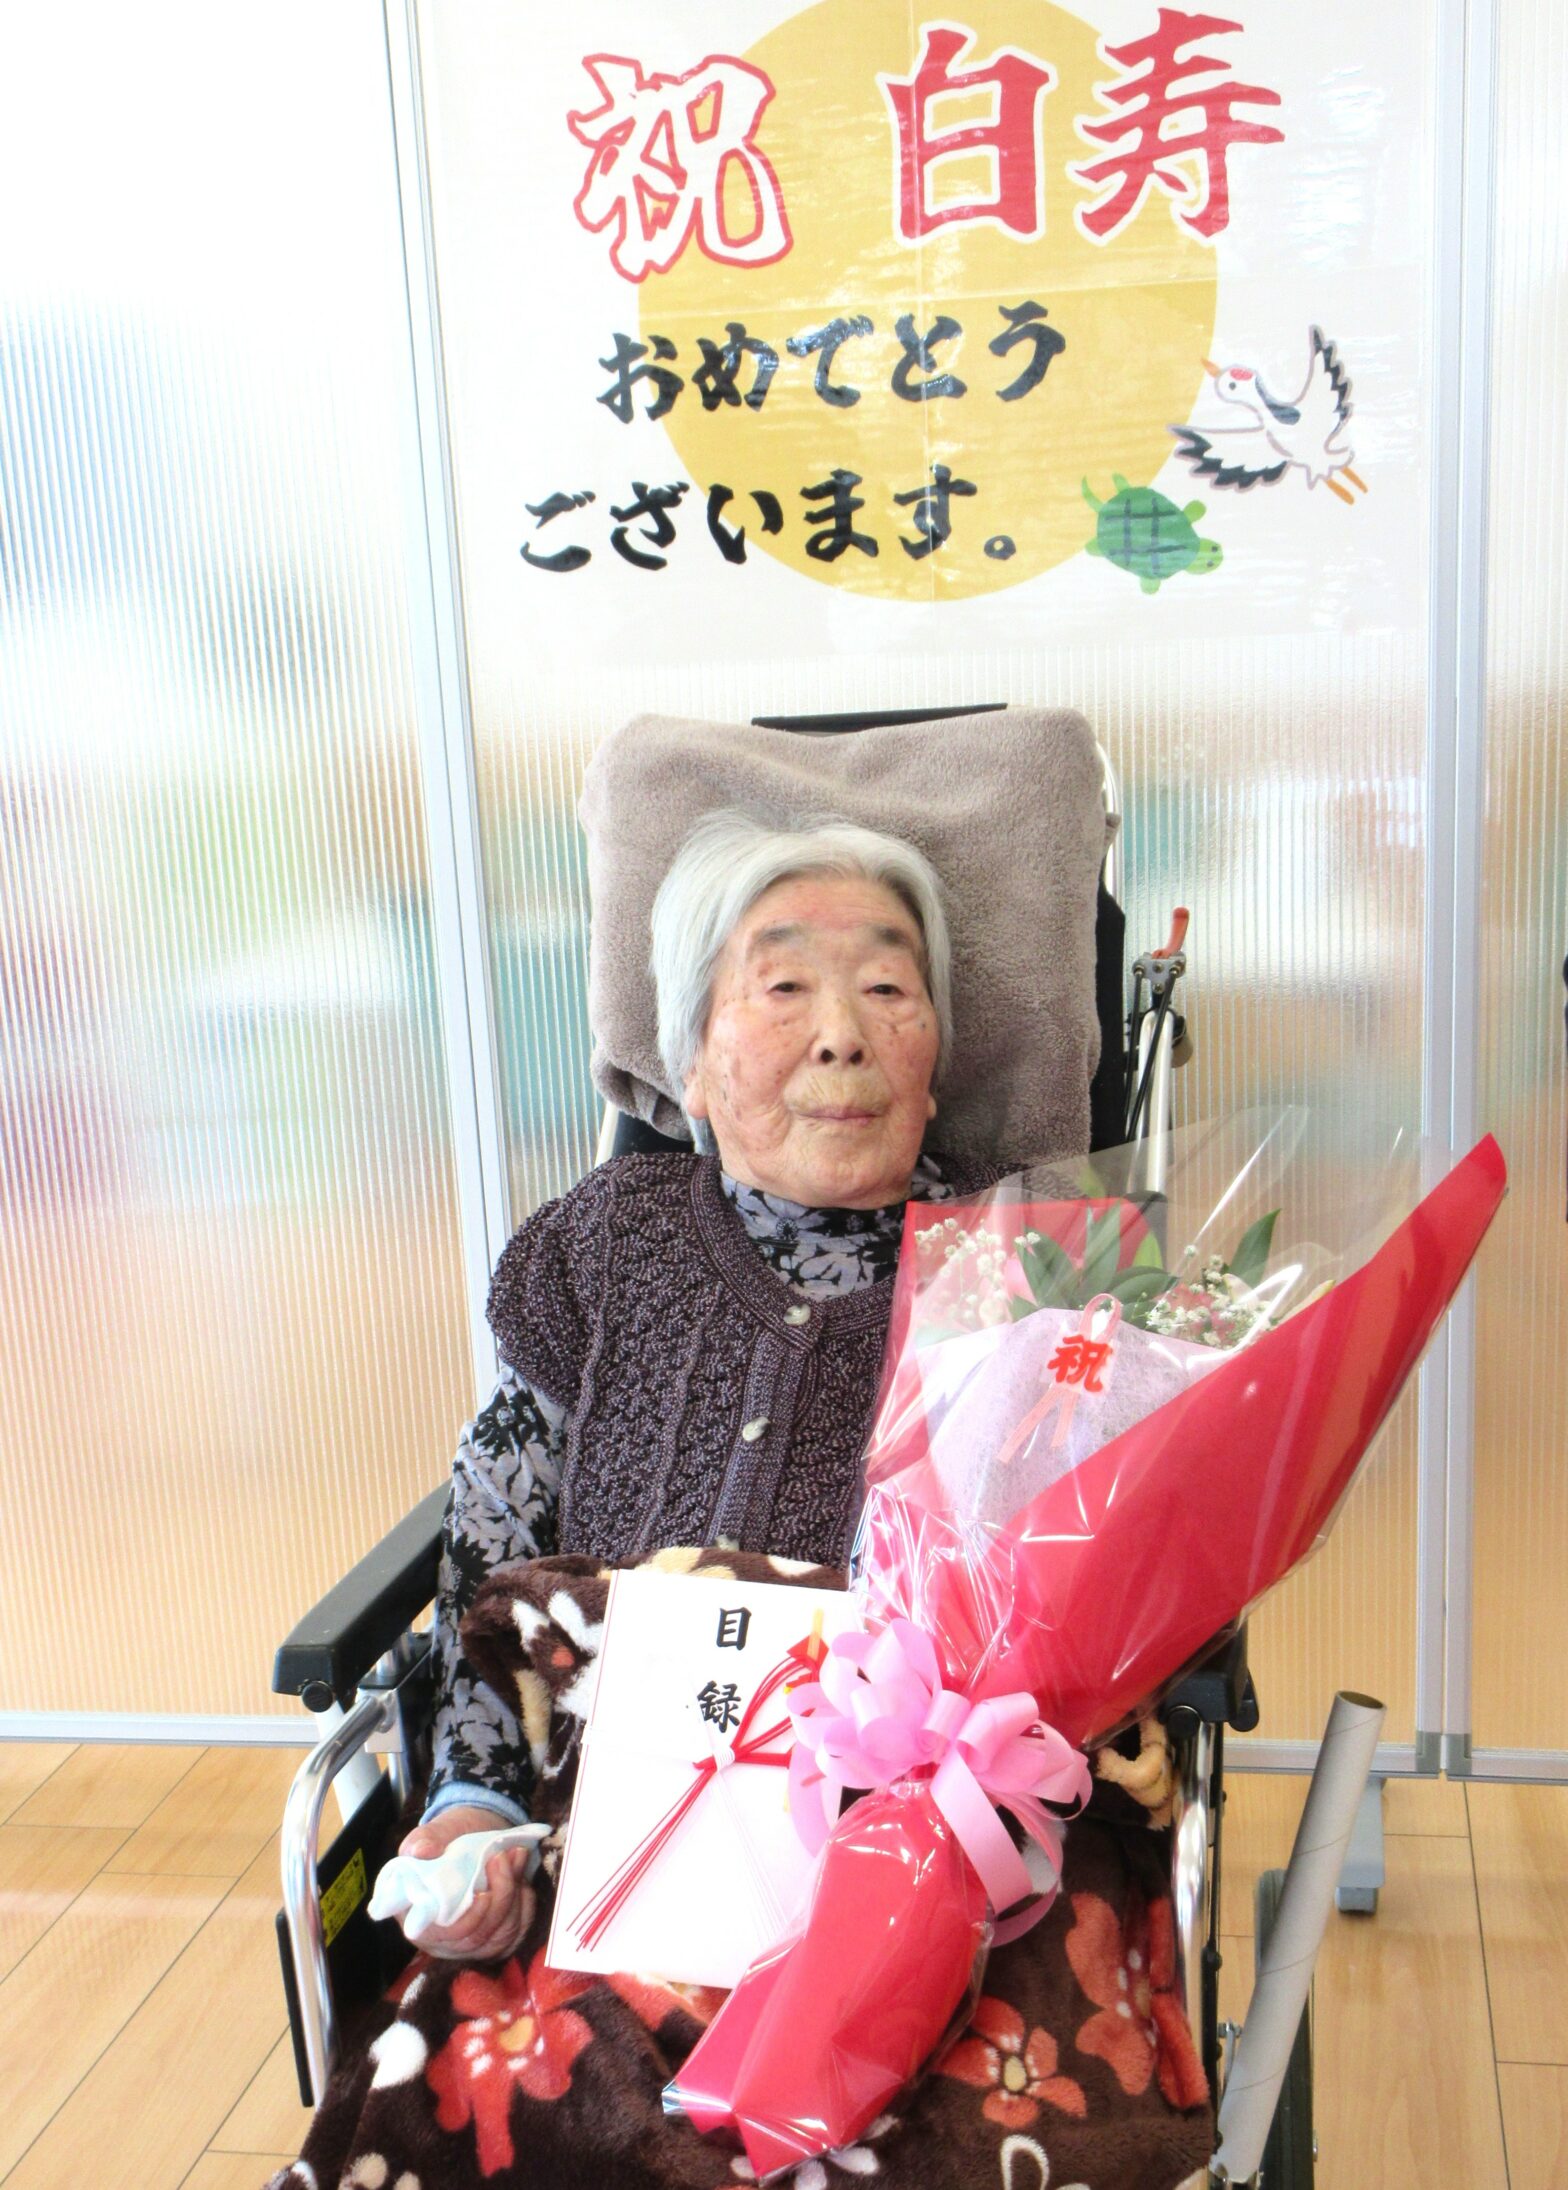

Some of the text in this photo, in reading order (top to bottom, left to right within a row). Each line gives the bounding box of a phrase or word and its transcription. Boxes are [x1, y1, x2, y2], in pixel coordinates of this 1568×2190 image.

[567, 6, 1285, 283] 祝 白寿
[596, 300, 1067, 425] おめでとう
[520, 464, 1018, 574] ございます。
[1047, 1334, 1113, 1392] 祝
[696, 1606, 752, 1733] 目録
